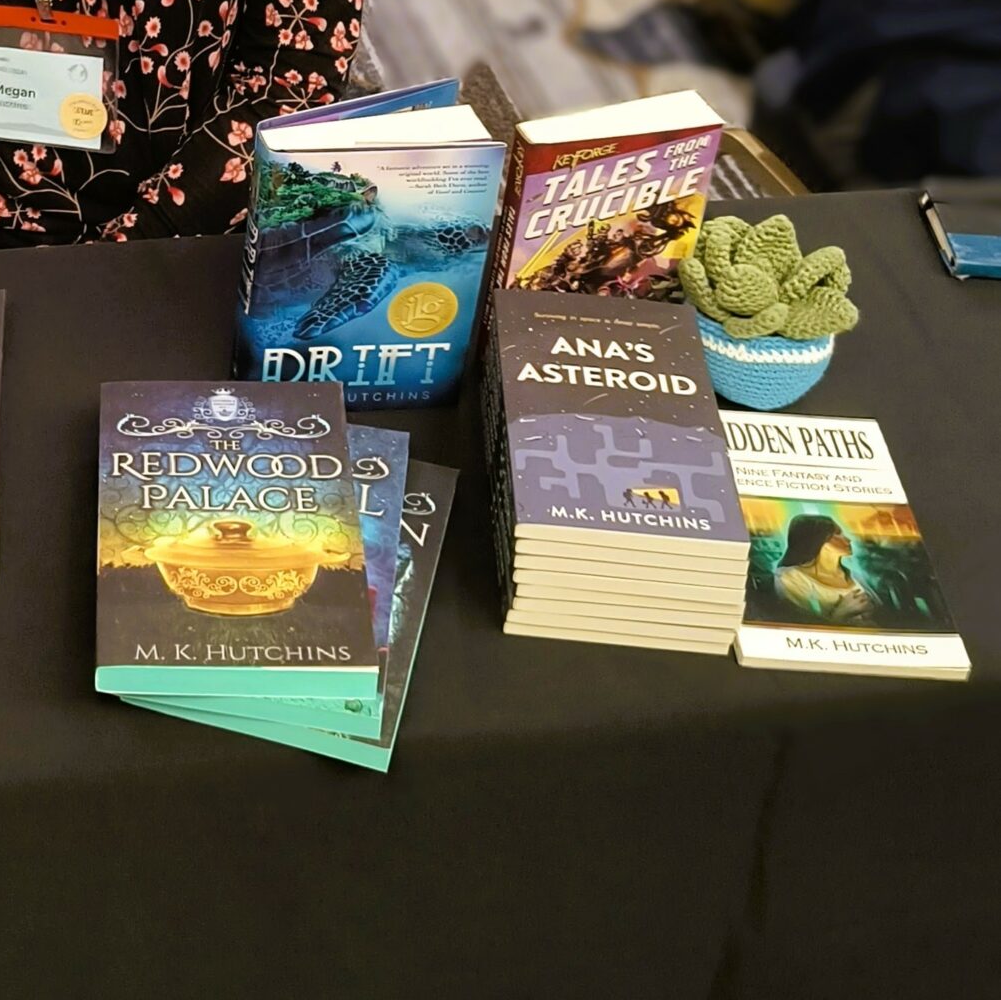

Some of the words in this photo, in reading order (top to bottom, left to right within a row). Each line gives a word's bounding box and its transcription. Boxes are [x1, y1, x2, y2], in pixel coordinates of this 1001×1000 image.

[663, 135, 711, 159] FROM
[668, 152, 700, 172] THE
[542, 150, 659, 206] TALES
[524, 167, 705, 240] CRUCIBLE
[551, 336, 655, 363] ANA'S
[262, 343, 451, 386] DRIFT
[516, 362, 698, 396] ASTEROID
[347, 390, 431, 402] UTCHINS
[209, 439, 241, 451] THE
[726, 421, 798, 455] DDEN
[798, 426, 875, 460] PATHS
[111, 452, 342, 481] REDWOOD
[735, 466, 770, 477] NINE
[772, 469, 831, 481] FANTASY
[834, 473, 863, 483] AND
[141, 483, 319, 513] PALACE
[736, 478, 774, 488] ENCE
[776, 479, 831, 492] FICTION
[833, 483, 893, 495] STORIES
[550, 505, 595, 522] M.K.
[601, 509, 711, 531] HUTCHINS
[134, 643, 166, 661] M.
[174, 643, 197, 661] K.
[206, 643, 351, 662] HUTCHINS
[785, 636, 829, 651] M.K.
[832, 639, 929, 655] HUTCHINS
